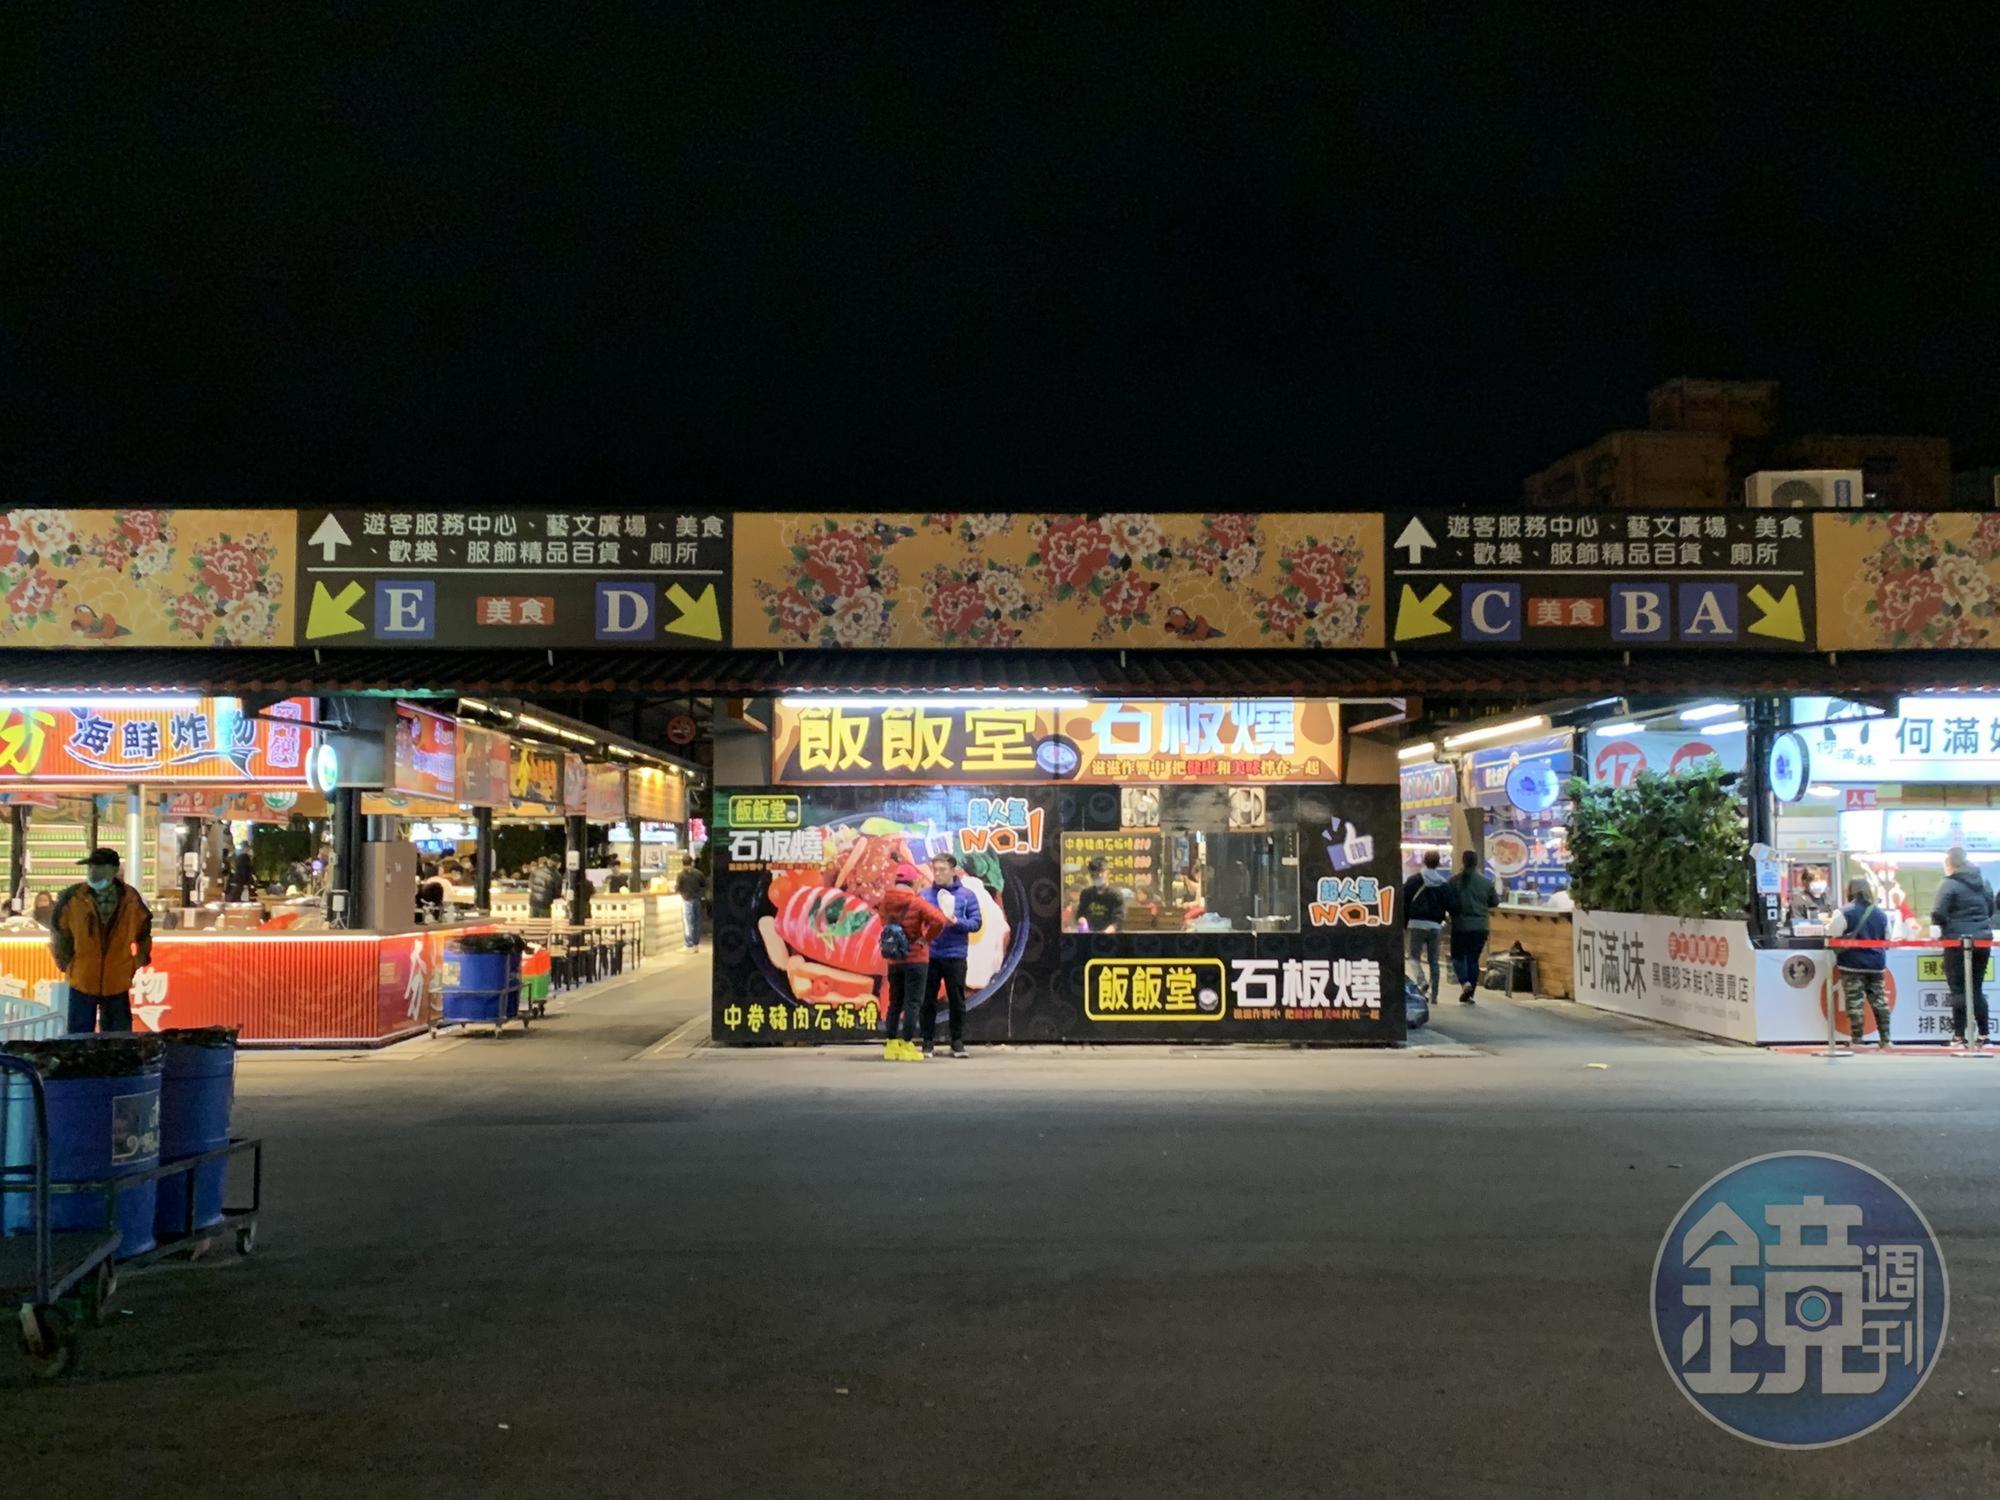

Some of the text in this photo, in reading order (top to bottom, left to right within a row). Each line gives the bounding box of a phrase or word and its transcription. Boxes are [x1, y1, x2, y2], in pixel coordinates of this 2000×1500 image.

[363, 512, 724, 538] 遊客服務中心、藝文廣場、美食
[1446, 515, 1803, 539] 遊客服務中心、藝文廣場、美食
[384, 588, 426, 632] E
[486, 598, 546, 625] 美食
[602, 590, 649, 632] D
[1470, 590, 1513, 635] C
[1536, 599, 1596, 625] 美食
[1619, 591, 1733, 634] B A
[799, 706, 1037, 773] 飯飯堂
[1091, 702, 1296, 755] 石板燒
[736, 799, 787, 822] 飯飯堂
[728, 830, 823, 861] 石板燒
[1231, 958, 1381, 1008] 石板燒
[1577, 926, 1647, 1000] 何滿妹
[1098, 965, 1197, 1011] 飯飯堂
[723, 1002, 878, 1033] 中卷豬肉石板燒
